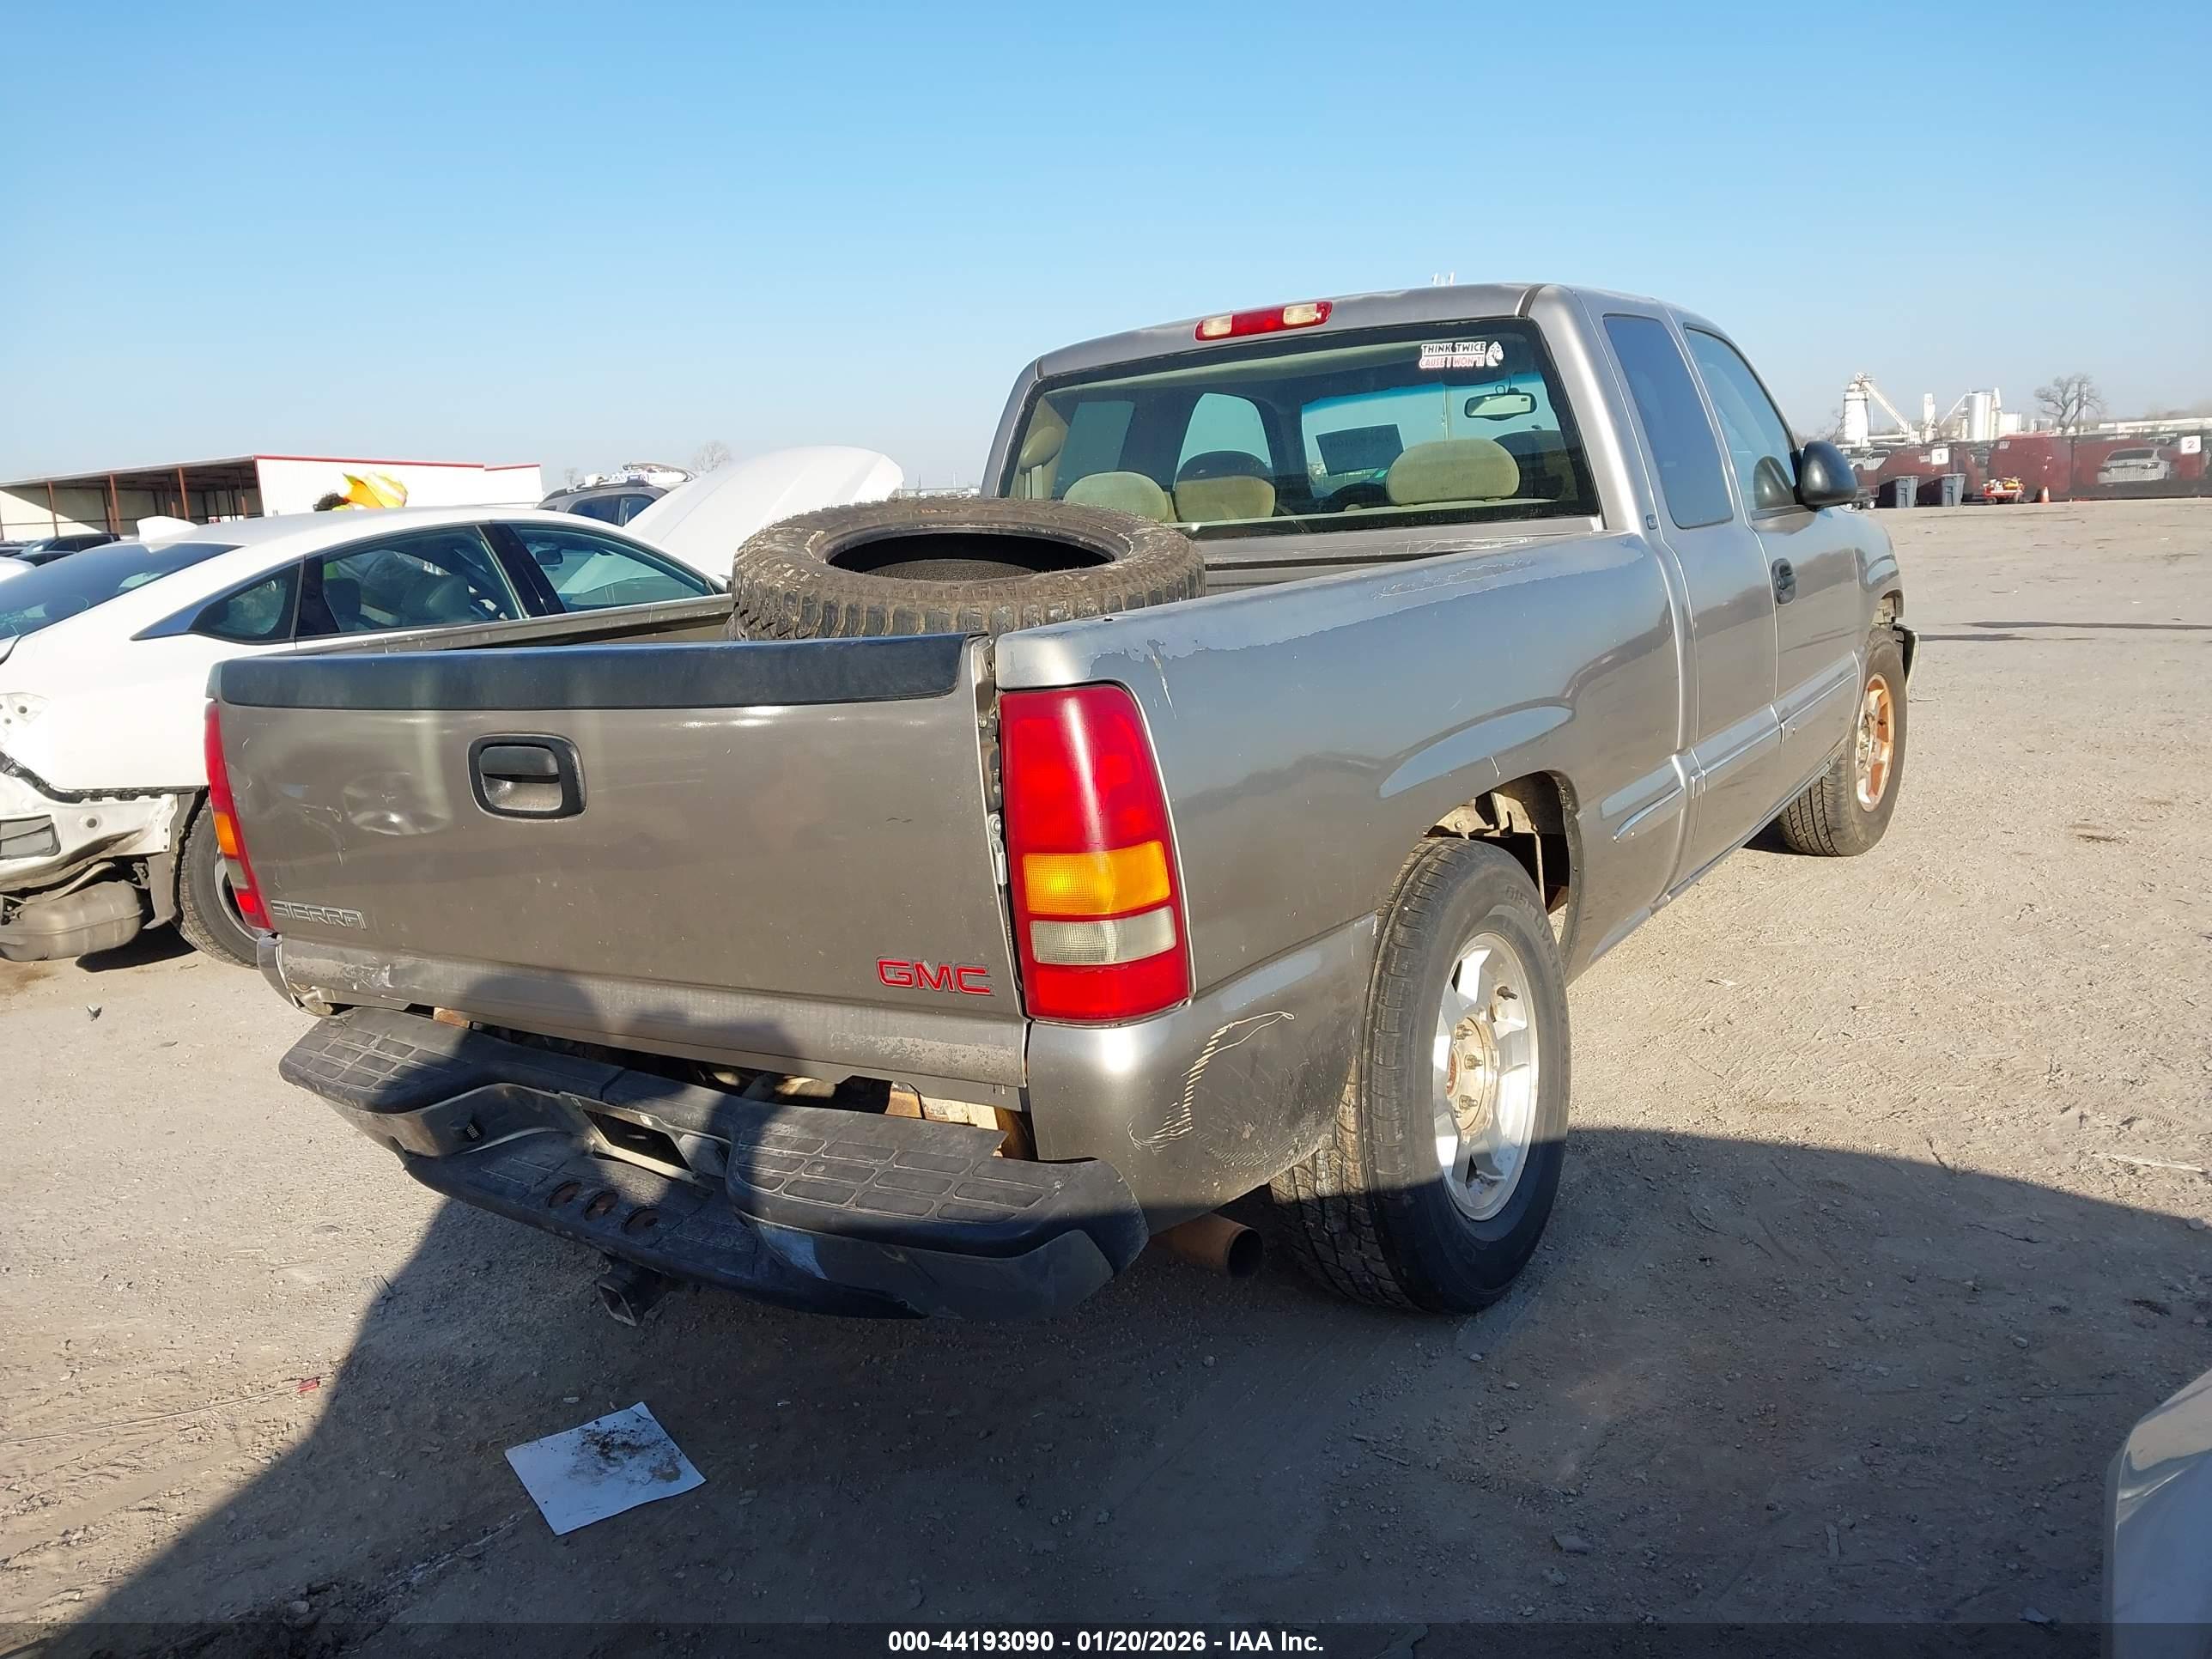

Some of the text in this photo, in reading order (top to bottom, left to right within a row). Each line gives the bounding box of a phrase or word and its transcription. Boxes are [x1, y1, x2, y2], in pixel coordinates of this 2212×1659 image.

[1422, 343, 1485, 354] THINK TWICE
[1420, 356, 1444, 368] CAUSE
[2186, 440, 2196, 449] 2
[270, 899, 367, 930] SIERRA
[876, 955, 994, 996] GMC
